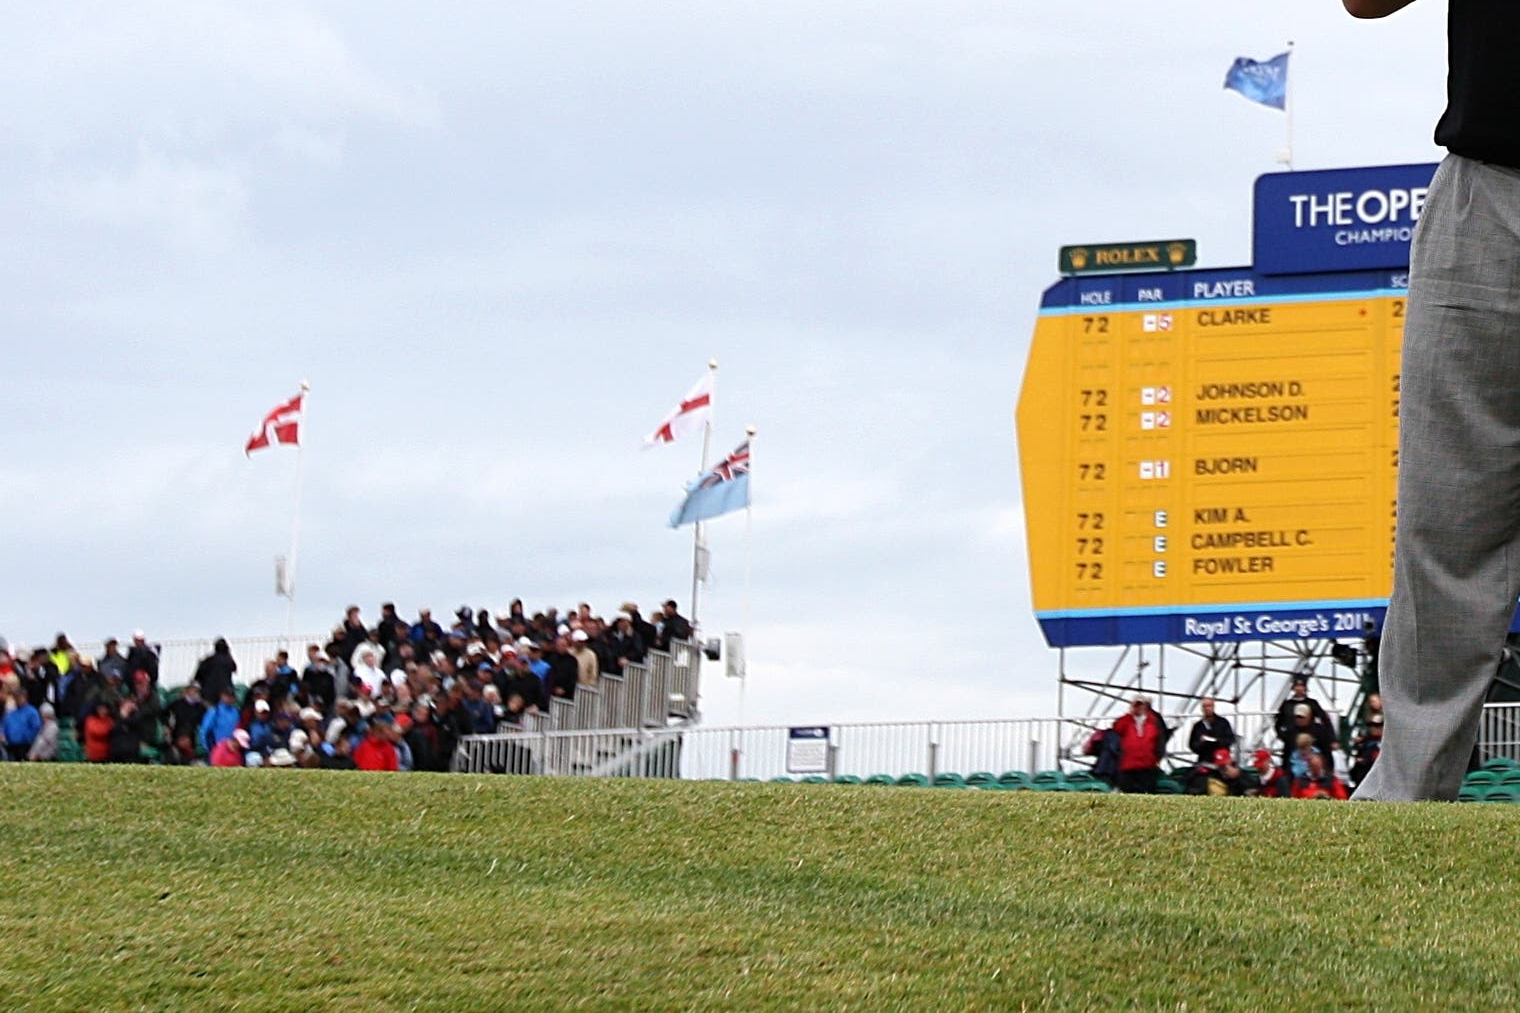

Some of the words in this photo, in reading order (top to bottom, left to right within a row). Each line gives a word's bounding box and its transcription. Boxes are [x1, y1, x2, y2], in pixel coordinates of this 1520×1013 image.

[1289, 192, 1353, 227] THE
[1335, 227, 1415, 245] CHAMPIO
[1095, 247, 1160, 265] ROLEX
[1081, 290, 1112, 305] HOLE
[1138, 288, 1163, 302] PAR
[1194, 280, 1255, 299] PLAYER
[1083, 317, 1108, 334] 72
[1145, 313, 1172, 332] -5
[1197, 308, 1271, 327] CLARKE
[1081, 389, 1107, 406] 72
[1144, 386, 1171, 405] -2
[1196, 383, 1283, 400] JOHNSON
[1288, 381, 1304, 396] D.
[1081, 414, 1107, 430] 72
[1143, 410, 1170, 429] -2
[1196, 405, 1308, 424] MICKELSON
[1079, 464, 1105, 480] 72
[1195, 458, 1257, 475] BJORN
[1077, 513, 1104, 529] 72
[1154, 510, 1168, 527] E
[1194, 508, 1228, 525] KIM
[1233, 507, 1251, 523] A.
[1077, 538, 1103, 554] 72
[1154, 535, 1168, 552] E
[1191, 531, 1290, 549] CAMPBELL
[1295, 530, 1313, 546] C.
[1076, 563, 1102, 579] 72
[1153, 560, 1167, 578] E
[1192, 557, 1274, 574] FOWLER
[1185, 617, 1230, 639] Royal
[1234, 615, 1252, 634] St
[1255, 613, 1330, 637] George's
